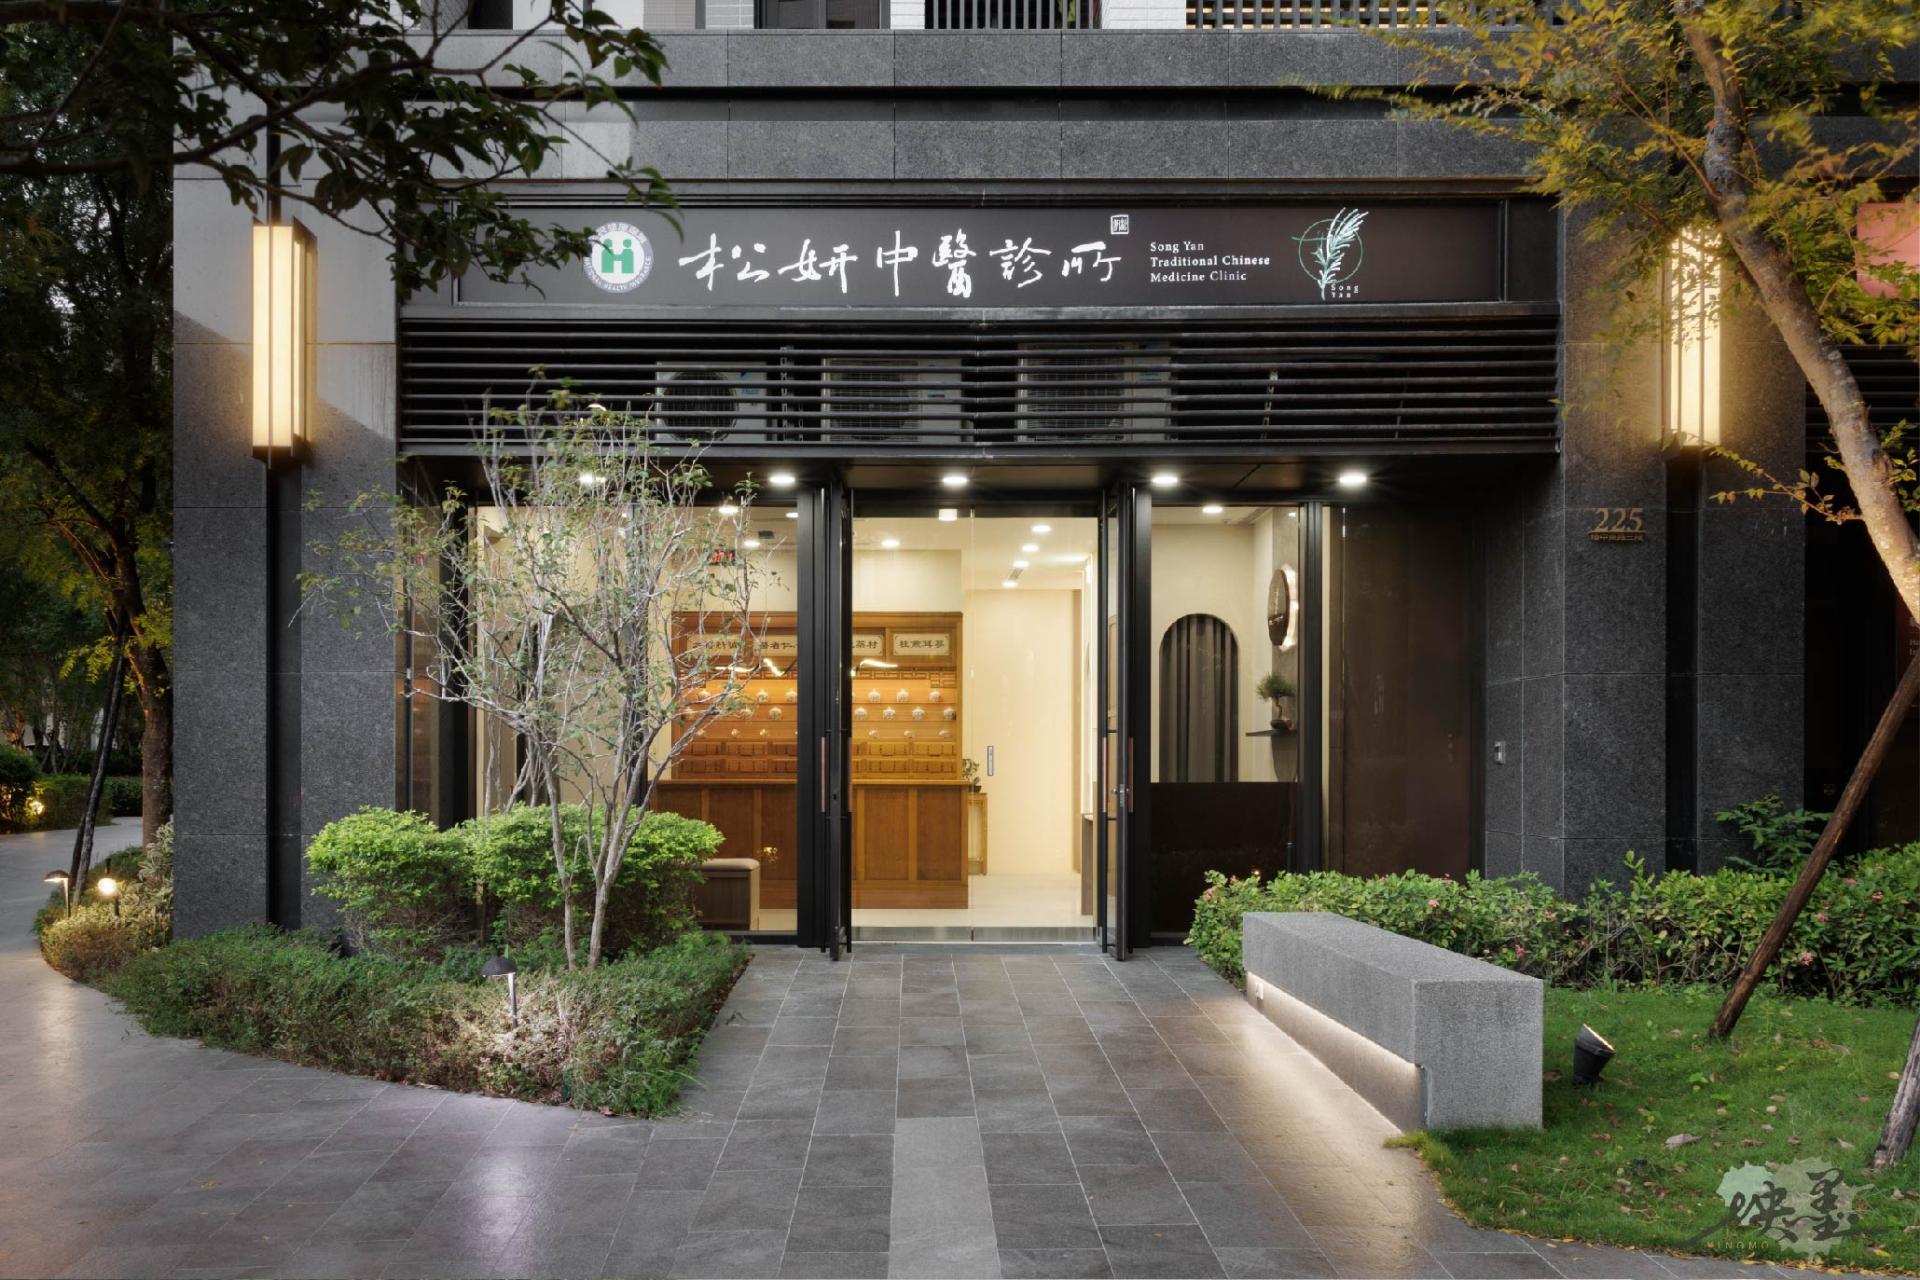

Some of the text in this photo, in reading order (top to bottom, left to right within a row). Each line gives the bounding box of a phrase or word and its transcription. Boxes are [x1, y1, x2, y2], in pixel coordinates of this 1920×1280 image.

[1150, 241, 1204, 253] Song Yan
[678, 229, 1122, 299] 松妍中醫診所
[1150, 255, 1270, 267] Traditional Chinese
[1150, 270, 1247, 283] Medicine Clinic
[1593, 507, 1644, 533] 225
